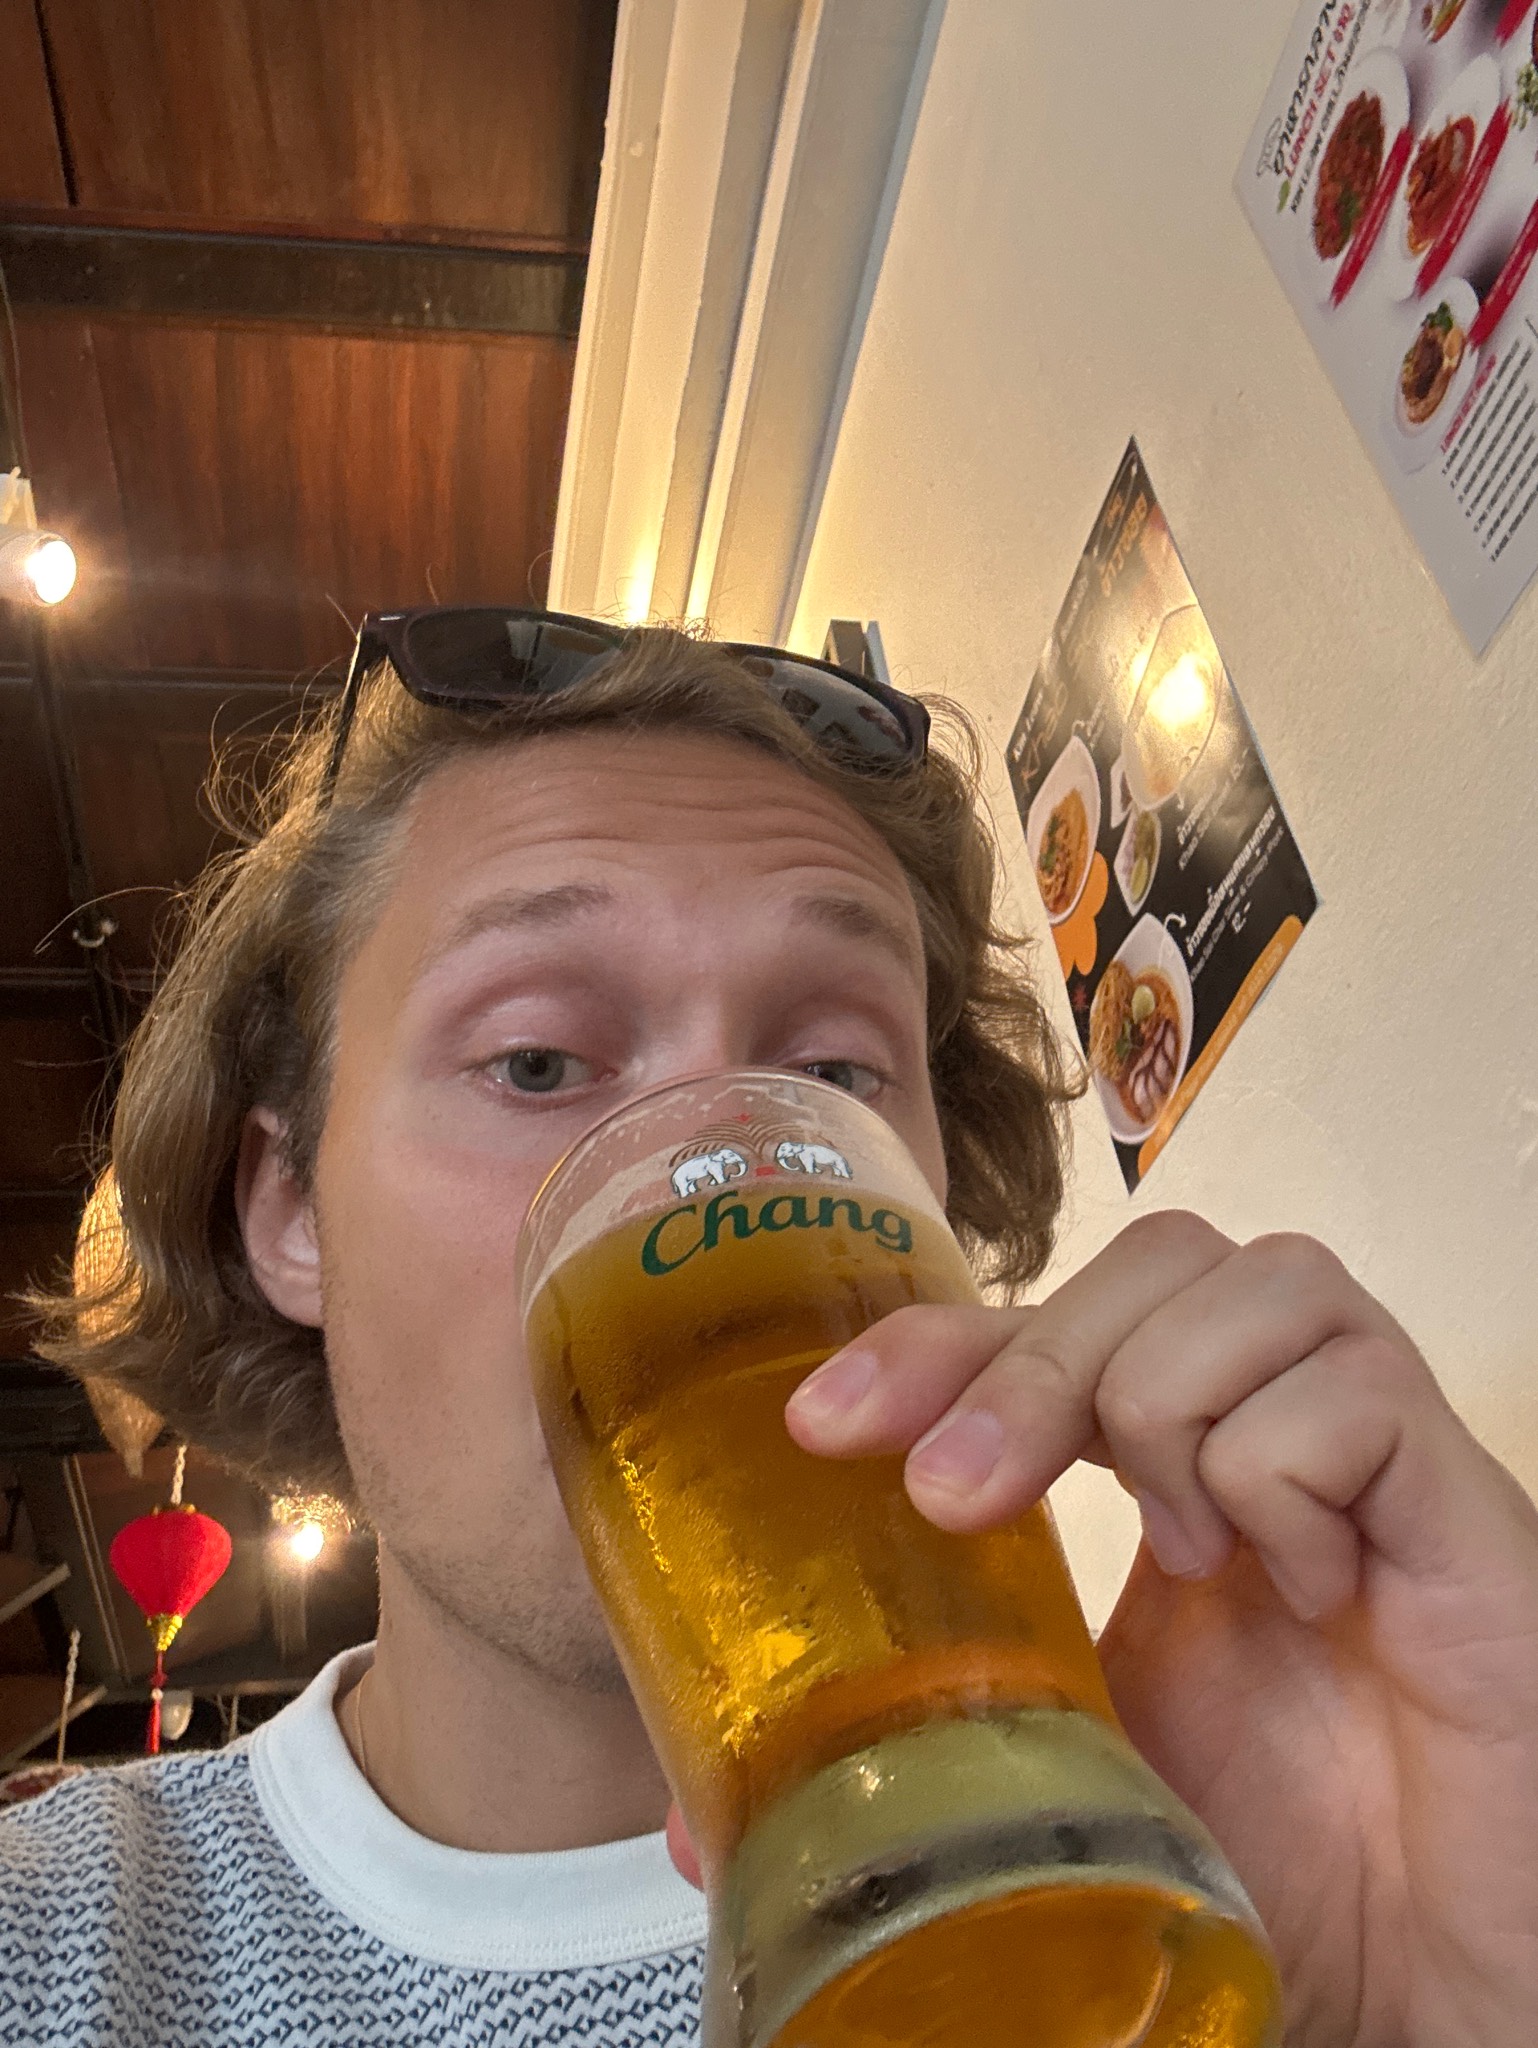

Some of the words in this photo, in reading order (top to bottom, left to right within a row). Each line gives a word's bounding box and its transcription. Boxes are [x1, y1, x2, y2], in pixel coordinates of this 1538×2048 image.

[1283, 98, 1317, 179] LUNCH
[1313, 42, 1336, 99] SET
[1178, 833, 1198, 872] Khao
[1244, 850, 1268, 889] Crispy
[1266, 823, 1284, 856] Pork
[641, 1190, 912, 1276] Chang
